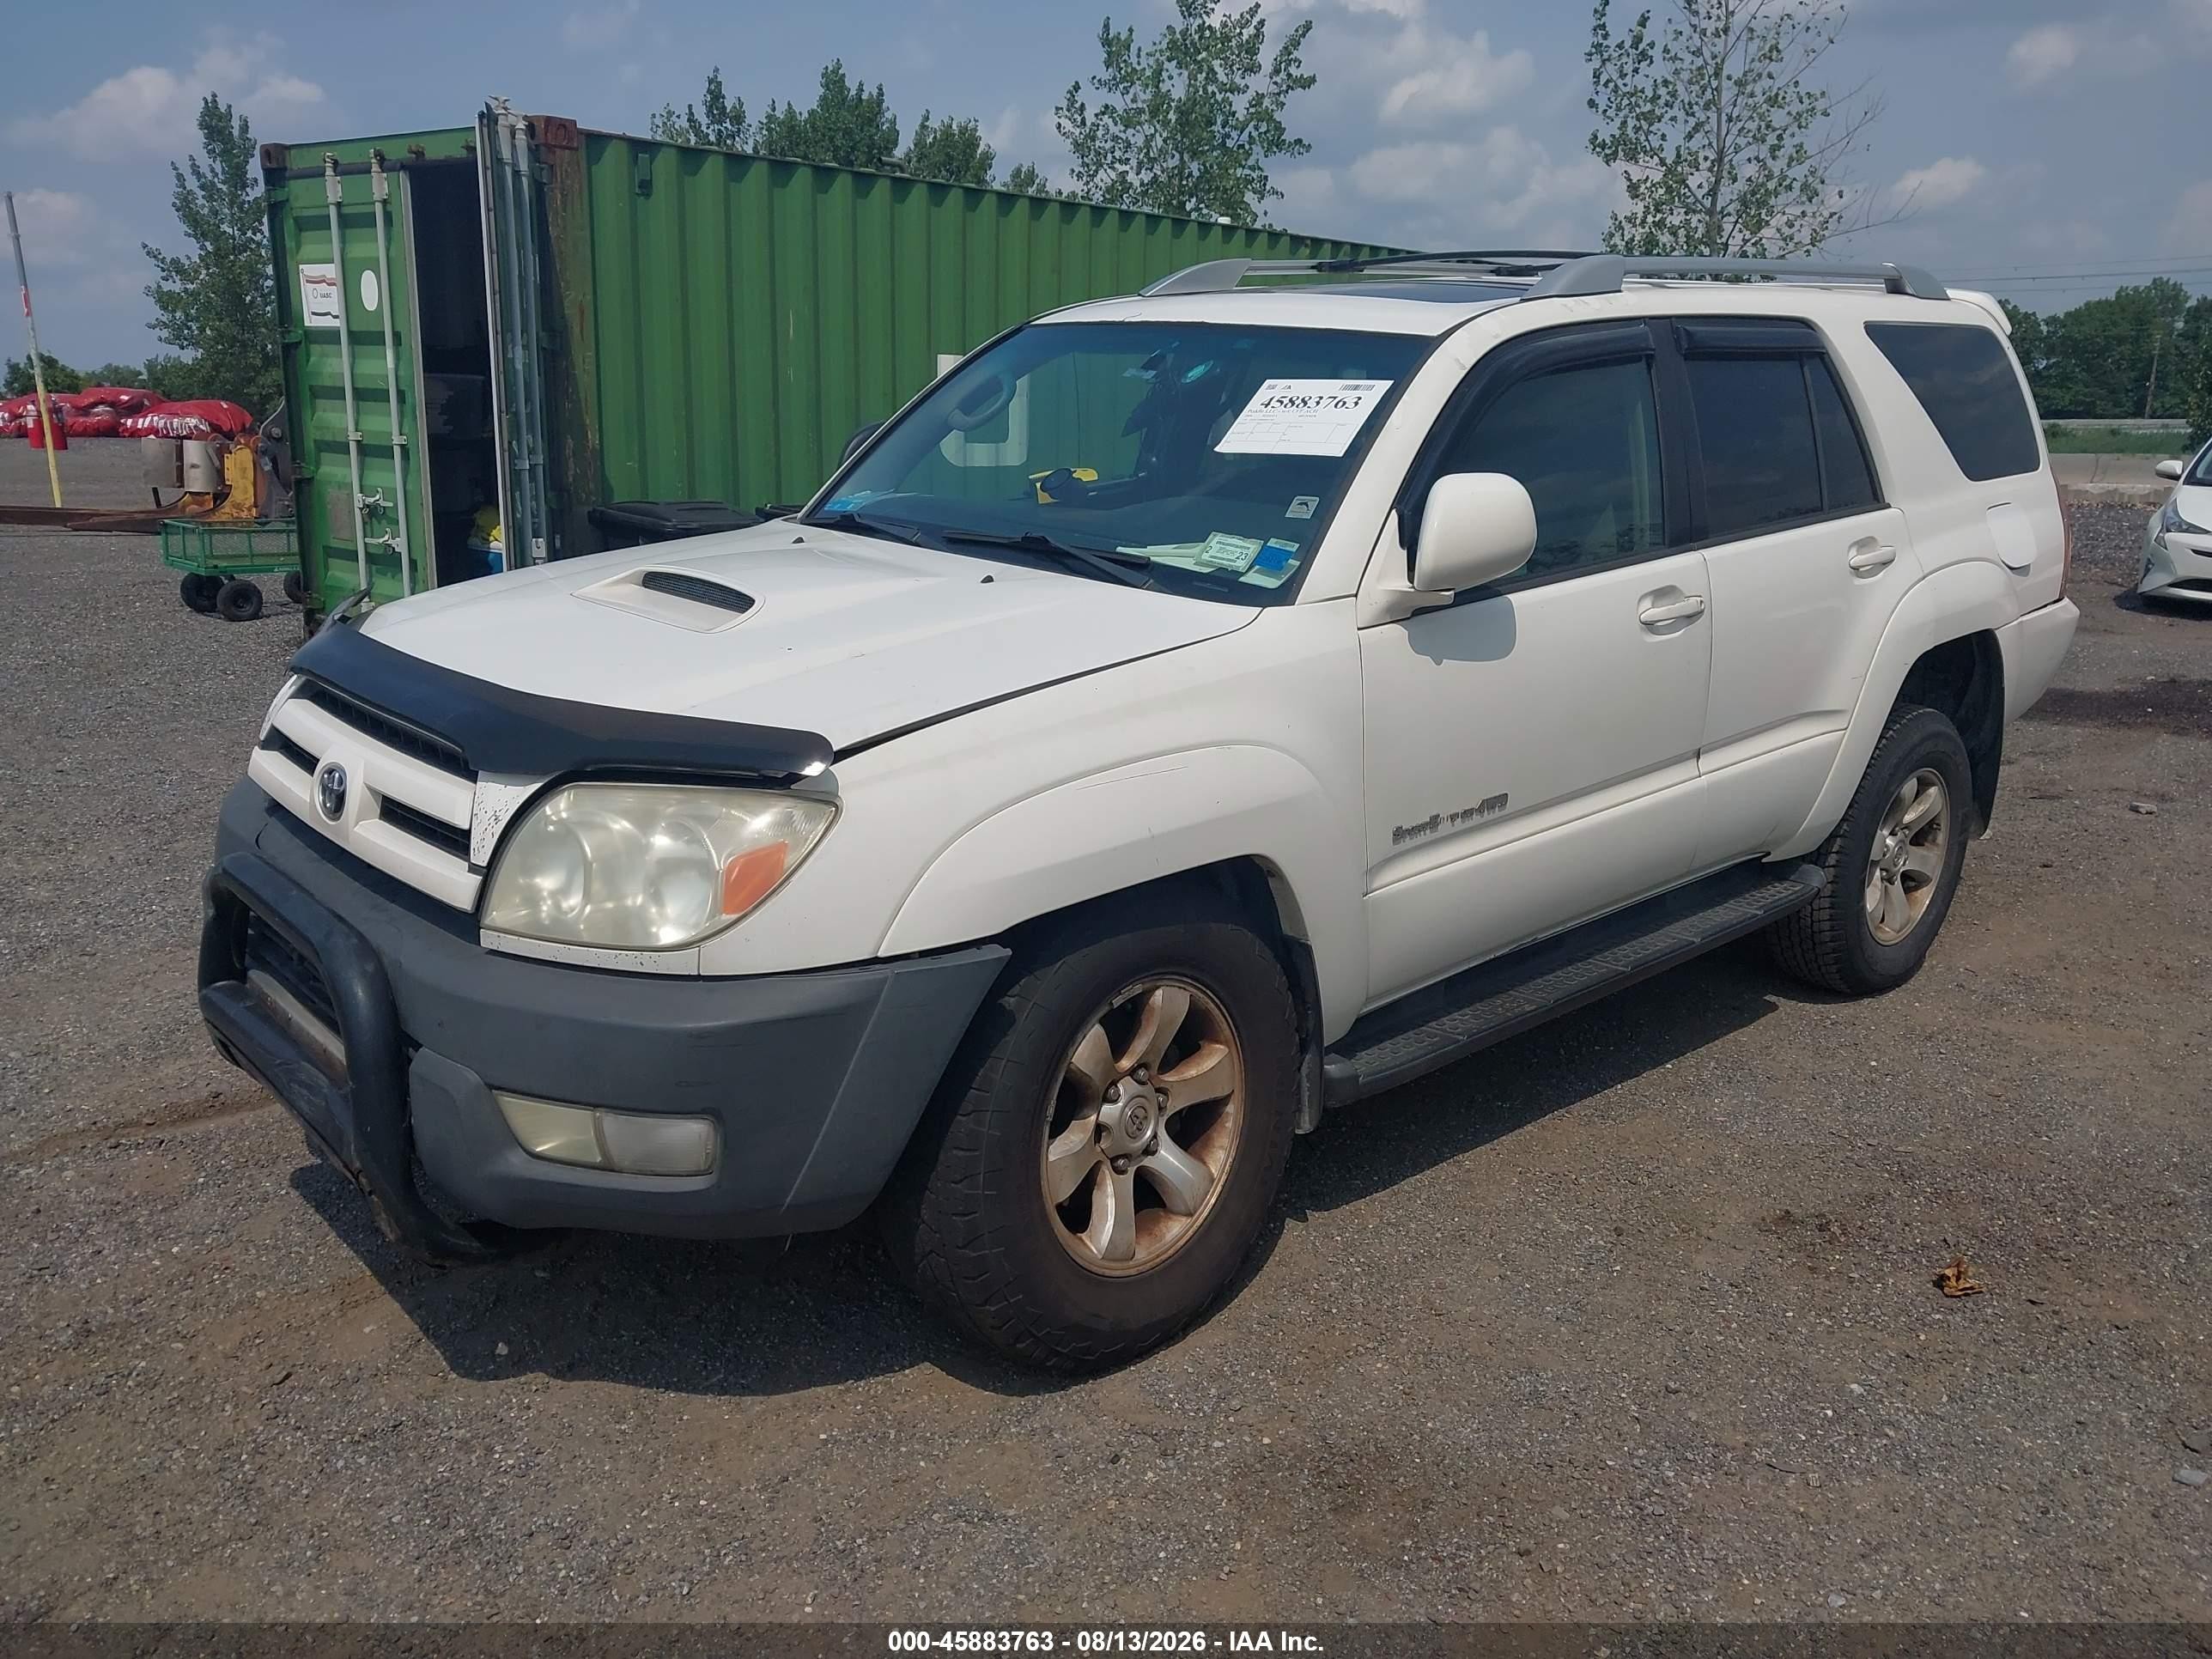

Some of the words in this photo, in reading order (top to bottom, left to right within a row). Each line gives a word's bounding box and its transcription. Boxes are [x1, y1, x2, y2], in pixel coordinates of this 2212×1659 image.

[1260, 395, 1363, 410] 45883763
[1205, 545, 1212, 554] 2
[1235, 551, 1249, 561] 23
